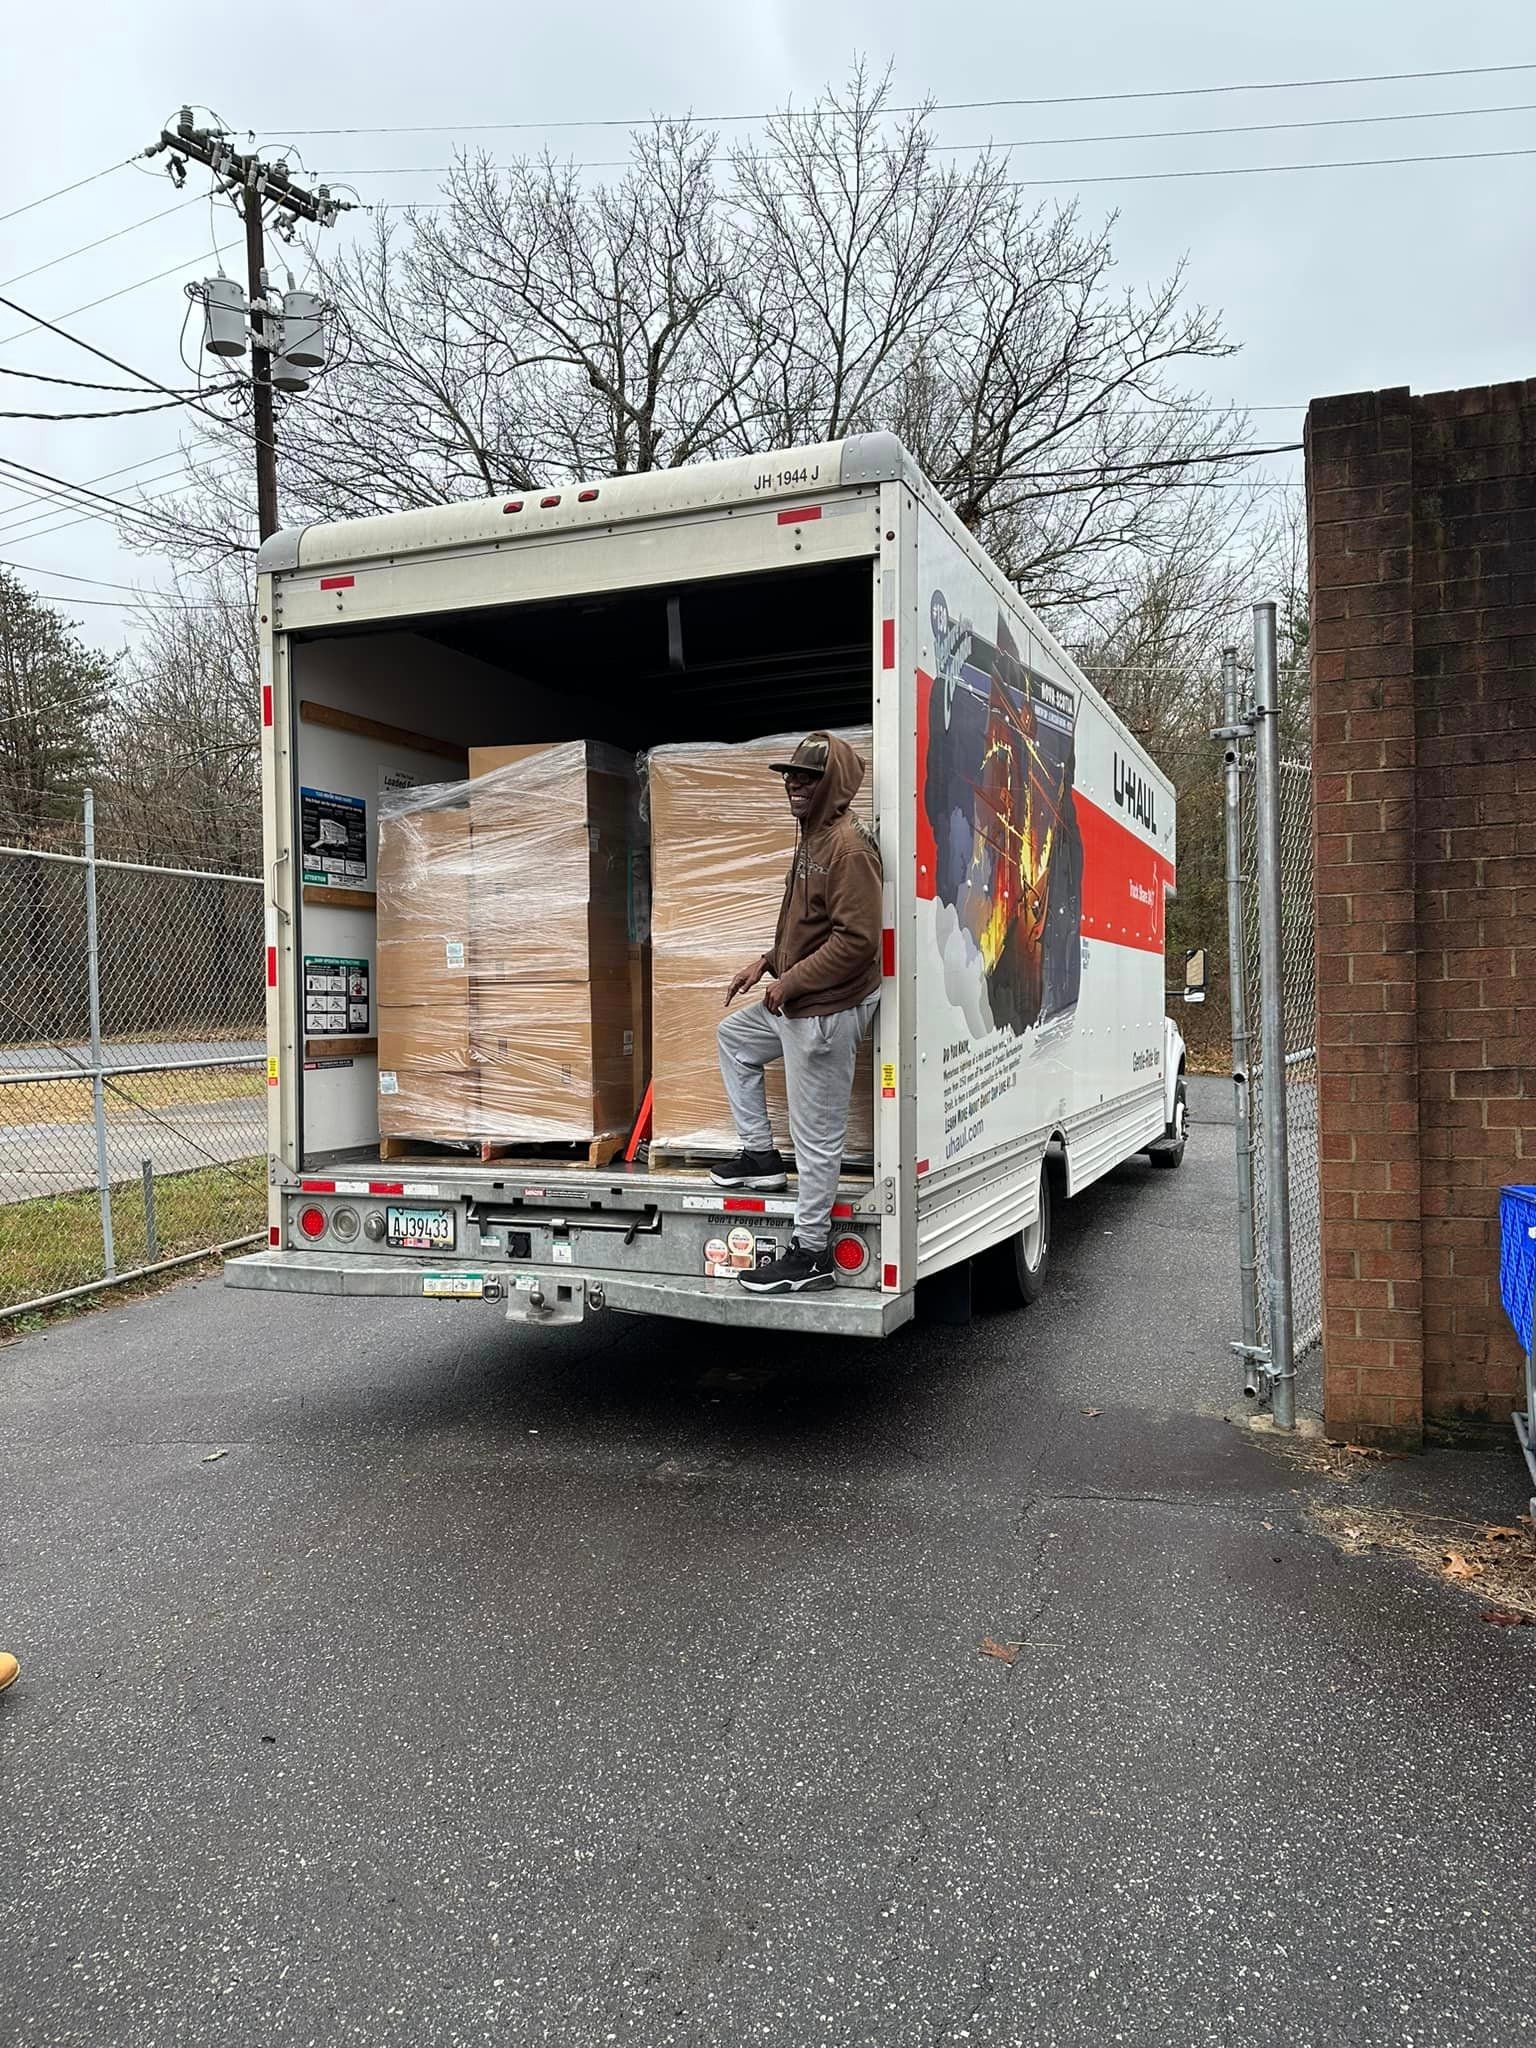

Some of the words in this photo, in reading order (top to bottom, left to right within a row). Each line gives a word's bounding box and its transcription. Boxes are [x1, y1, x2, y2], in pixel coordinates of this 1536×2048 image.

[754, 474, 771, 490] JH
[777, 467, 807, 487] 1944
[811, 465, 819, 480] J
[1114, 751, 1157, 835] U-HAUL
[945, 1119, 984, 1160] uhaul.com
[393, 1217, 448, 1238] AJ39433
[708, 1214, 731, 1225] Don't
[734, 1216, 762, 1228] Forget
[766, 1218, 784, 1228] Your
